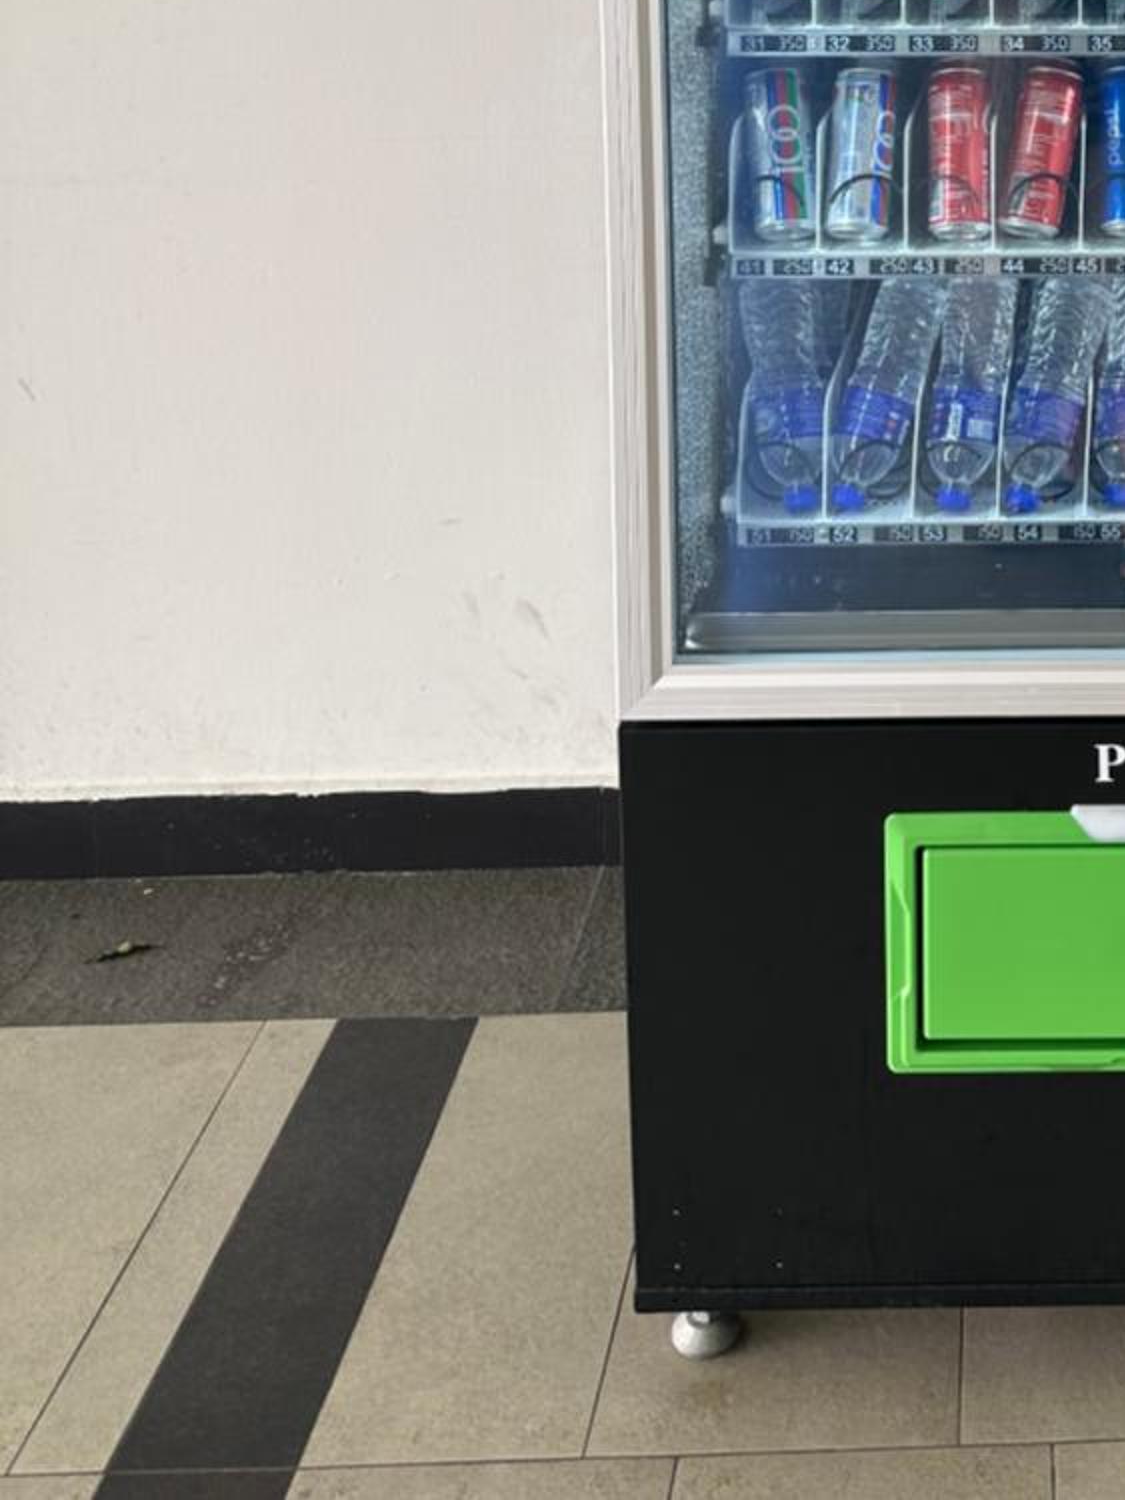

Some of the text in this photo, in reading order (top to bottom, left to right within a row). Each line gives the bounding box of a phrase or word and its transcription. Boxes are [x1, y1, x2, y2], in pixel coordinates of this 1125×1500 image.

[830, 36, 849, 49] 32
[913, 36, 933, 49] 33
[1006, 36, 1024, 49] 34
[1092, 36, 1112, 49] 35
[1105, 110, 1123, 165] pepsi
[829, 261, 849, 274] 42
[913, 261, 934, 274] 43
[1004, 261, 1024, 274] 44
[1076, 261, 1097, 274] 45
[833, 528, 856, 541] 52
[924, 527, 944, 540] 53
[1018, 527, 1038, 540] 54
[1101, 527, 1120, 540] 55
